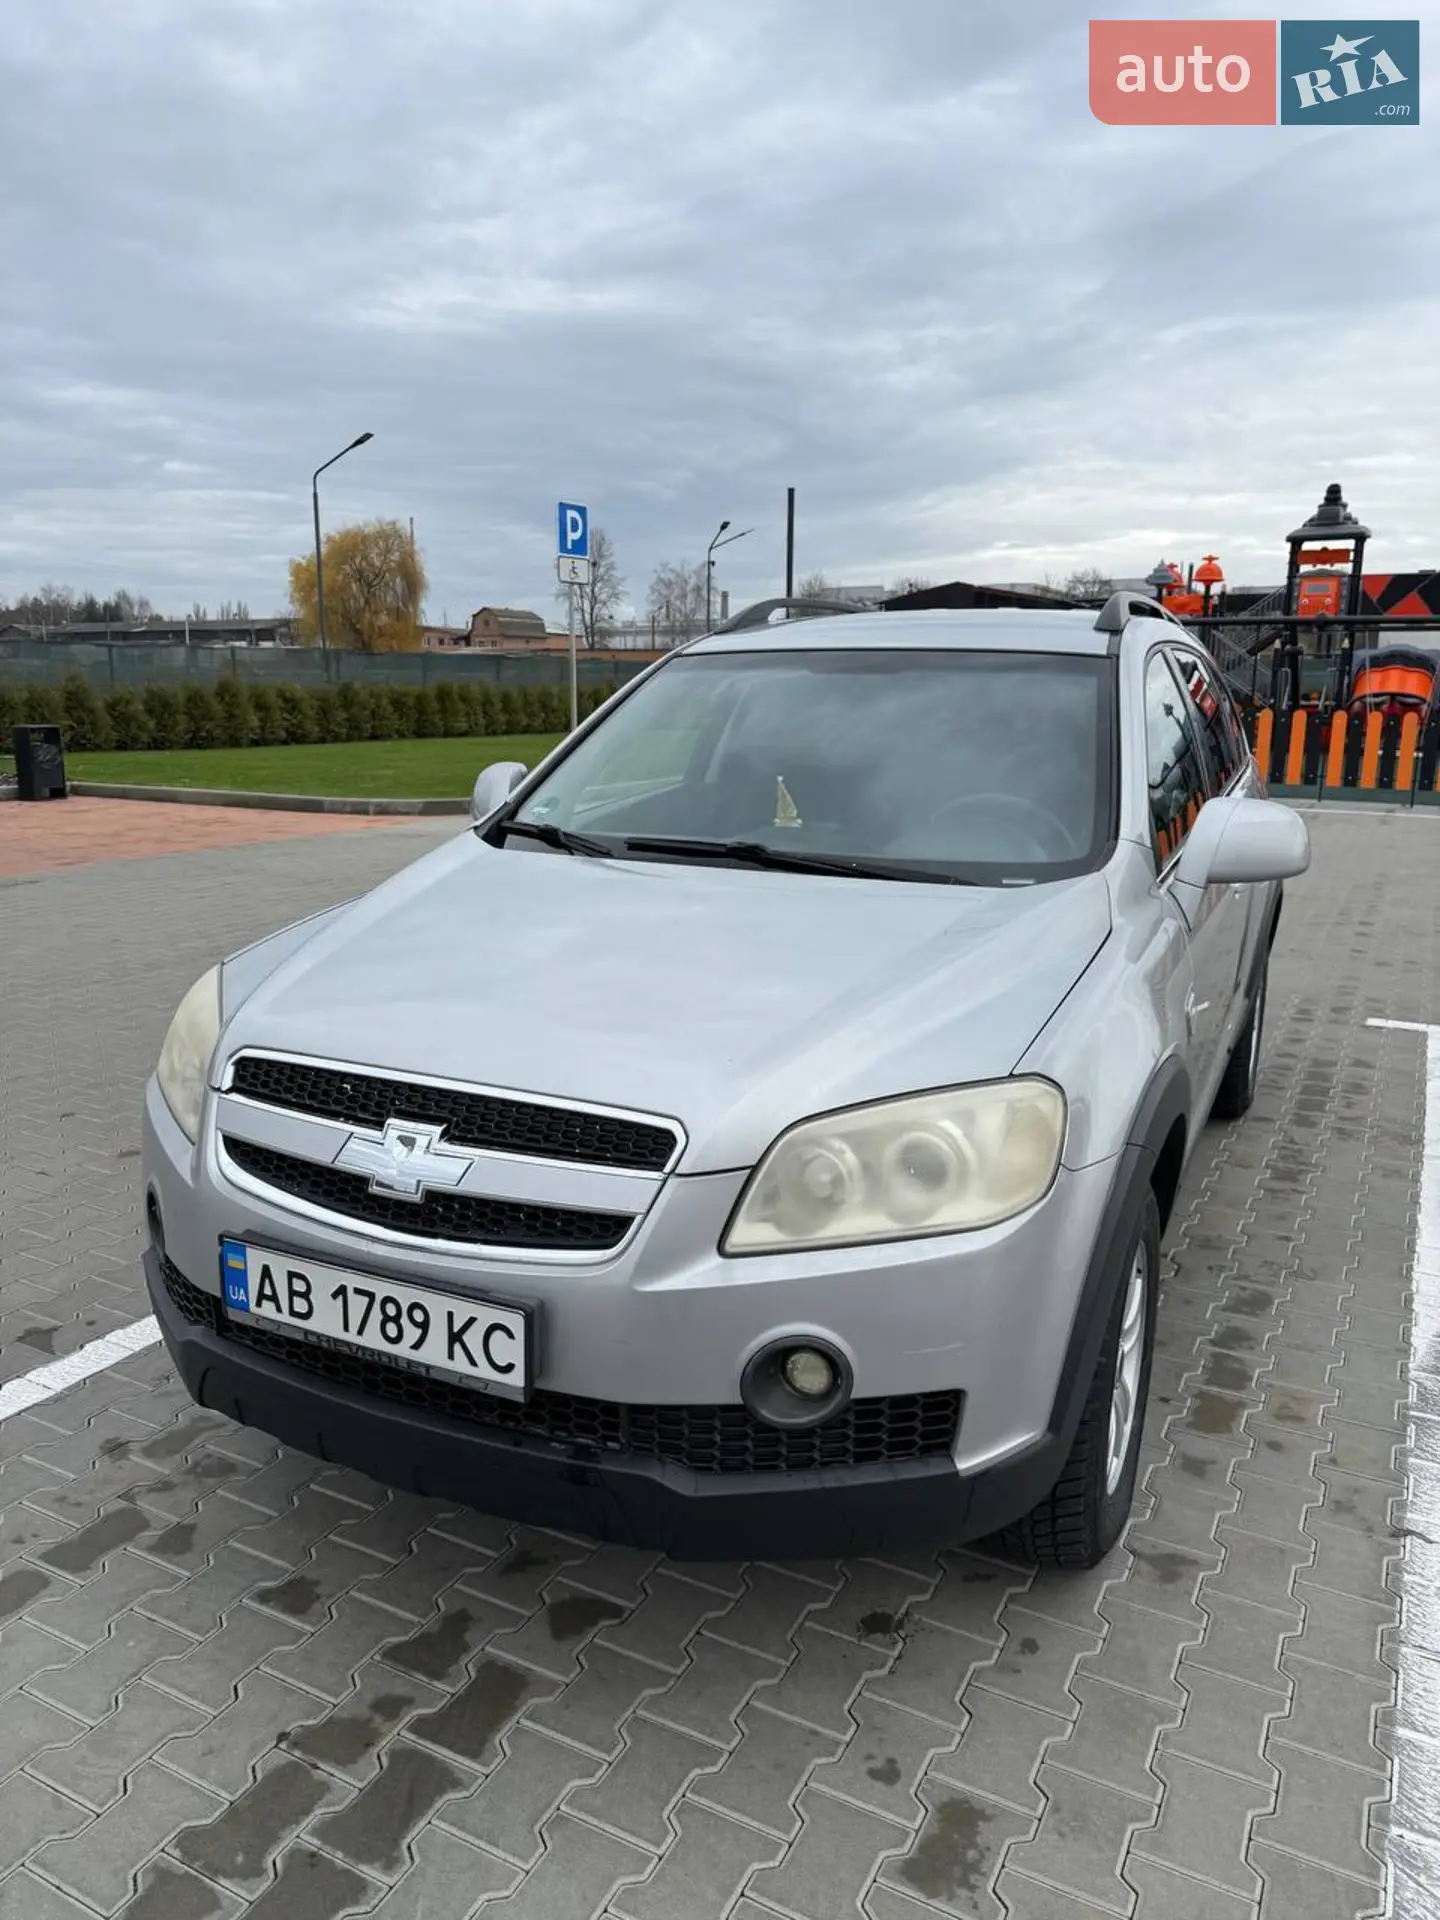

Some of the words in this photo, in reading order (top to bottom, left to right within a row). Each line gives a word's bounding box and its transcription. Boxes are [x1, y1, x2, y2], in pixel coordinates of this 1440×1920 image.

[566, 509, 583, 550] P
[229, 1284, 247, 1303] UA
[254, 1263, 314, 1321] AB
[330, 1283, 431, 1351] 1789
[446, 1310, 517, 1375] KC
